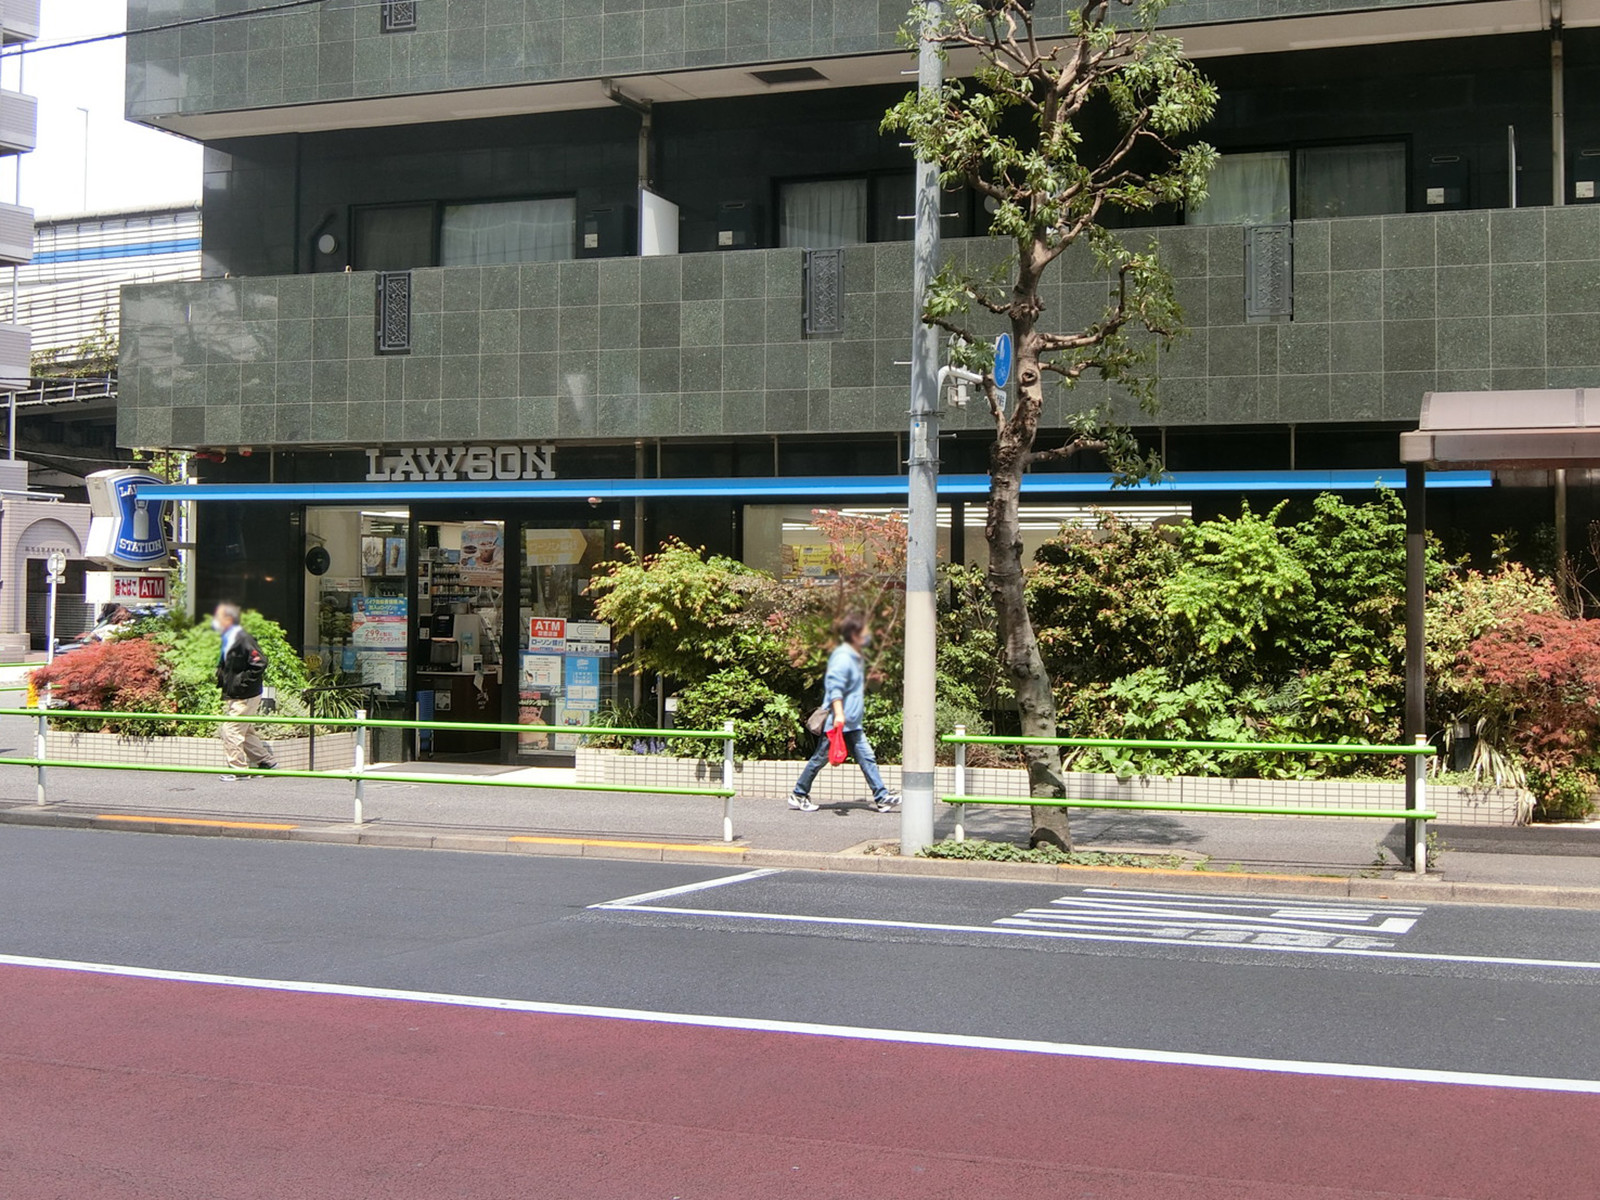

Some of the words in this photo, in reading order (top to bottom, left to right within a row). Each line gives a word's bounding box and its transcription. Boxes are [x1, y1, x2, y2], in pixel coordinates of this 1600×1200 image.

[366, 446, 556, 481] LAWSON
[119, 538, 163, 553] STATION
[141, 580, 164, 596] ATM
[535, 620, 561, 631] ATM
[531, 639, 565, 647] ローソン銀行
